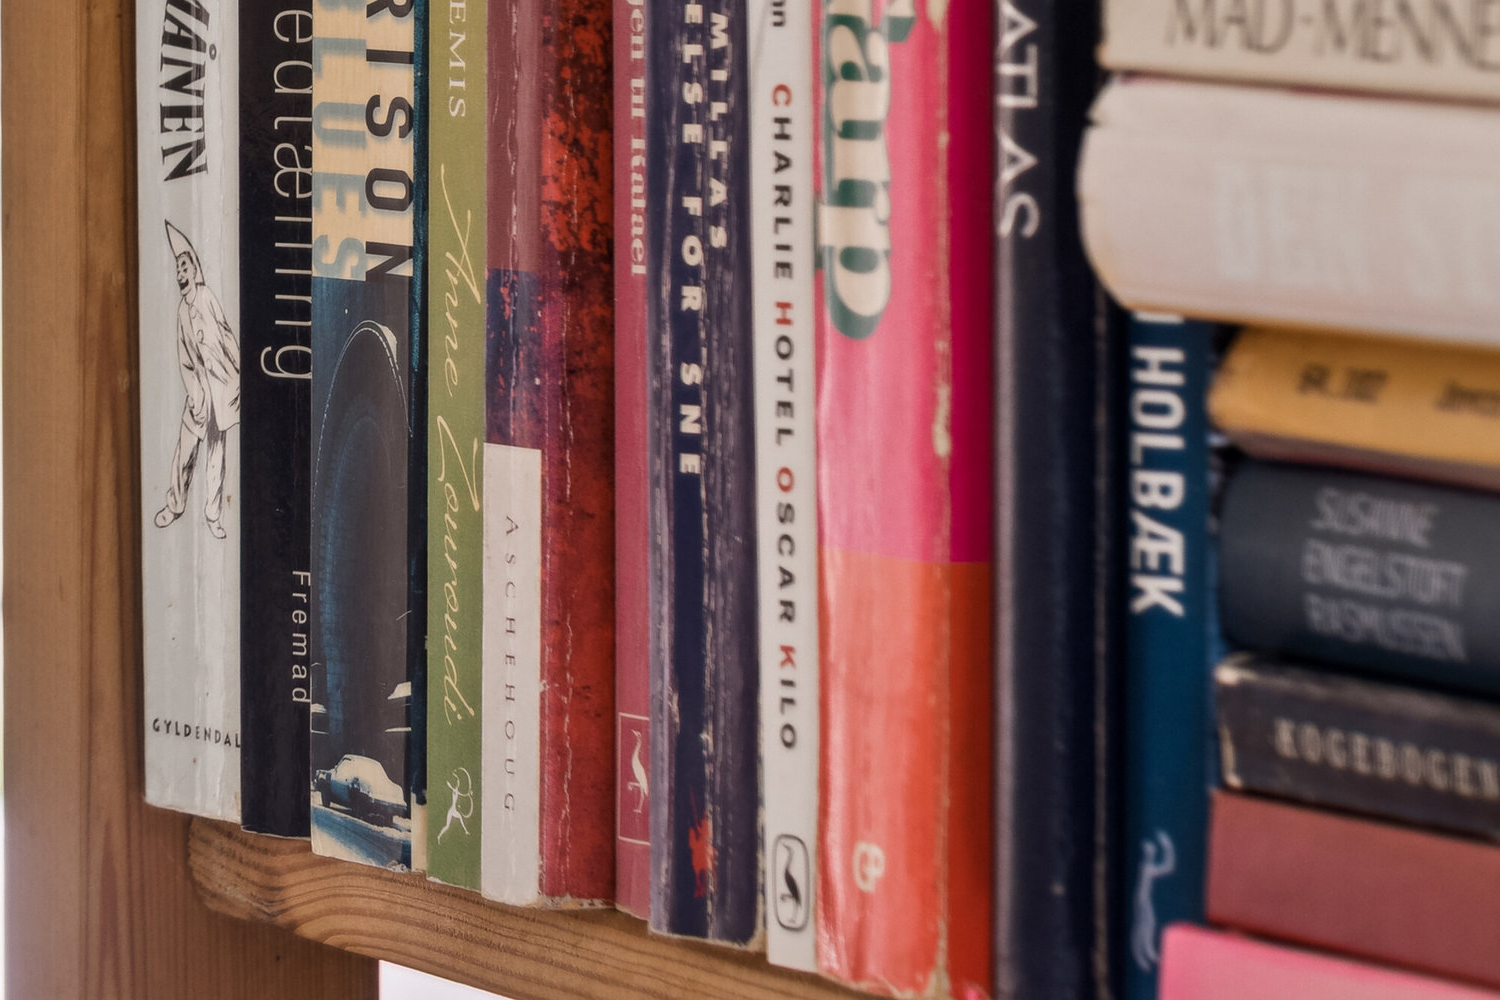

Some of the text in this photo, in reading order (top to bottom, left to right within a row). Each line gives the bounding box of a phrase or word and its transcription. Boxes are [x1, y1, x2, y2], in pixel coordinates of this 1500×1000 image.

[680, 197, 702, 312] FOR
[437, 163, 482, 726] Anne Zouroudi
[679, 361, 702, 475] SNE
[771, 84, 797, 750] CHARLIE HOTEL OSCAR KILO
[1130, 347, 1185, 618] HOLBÆK
[152, 717, 241, 748] GYLDENDAL
[291, 570, 312, 704] Fremad
[502, 515, 519, 812] ASCHEHOUG
